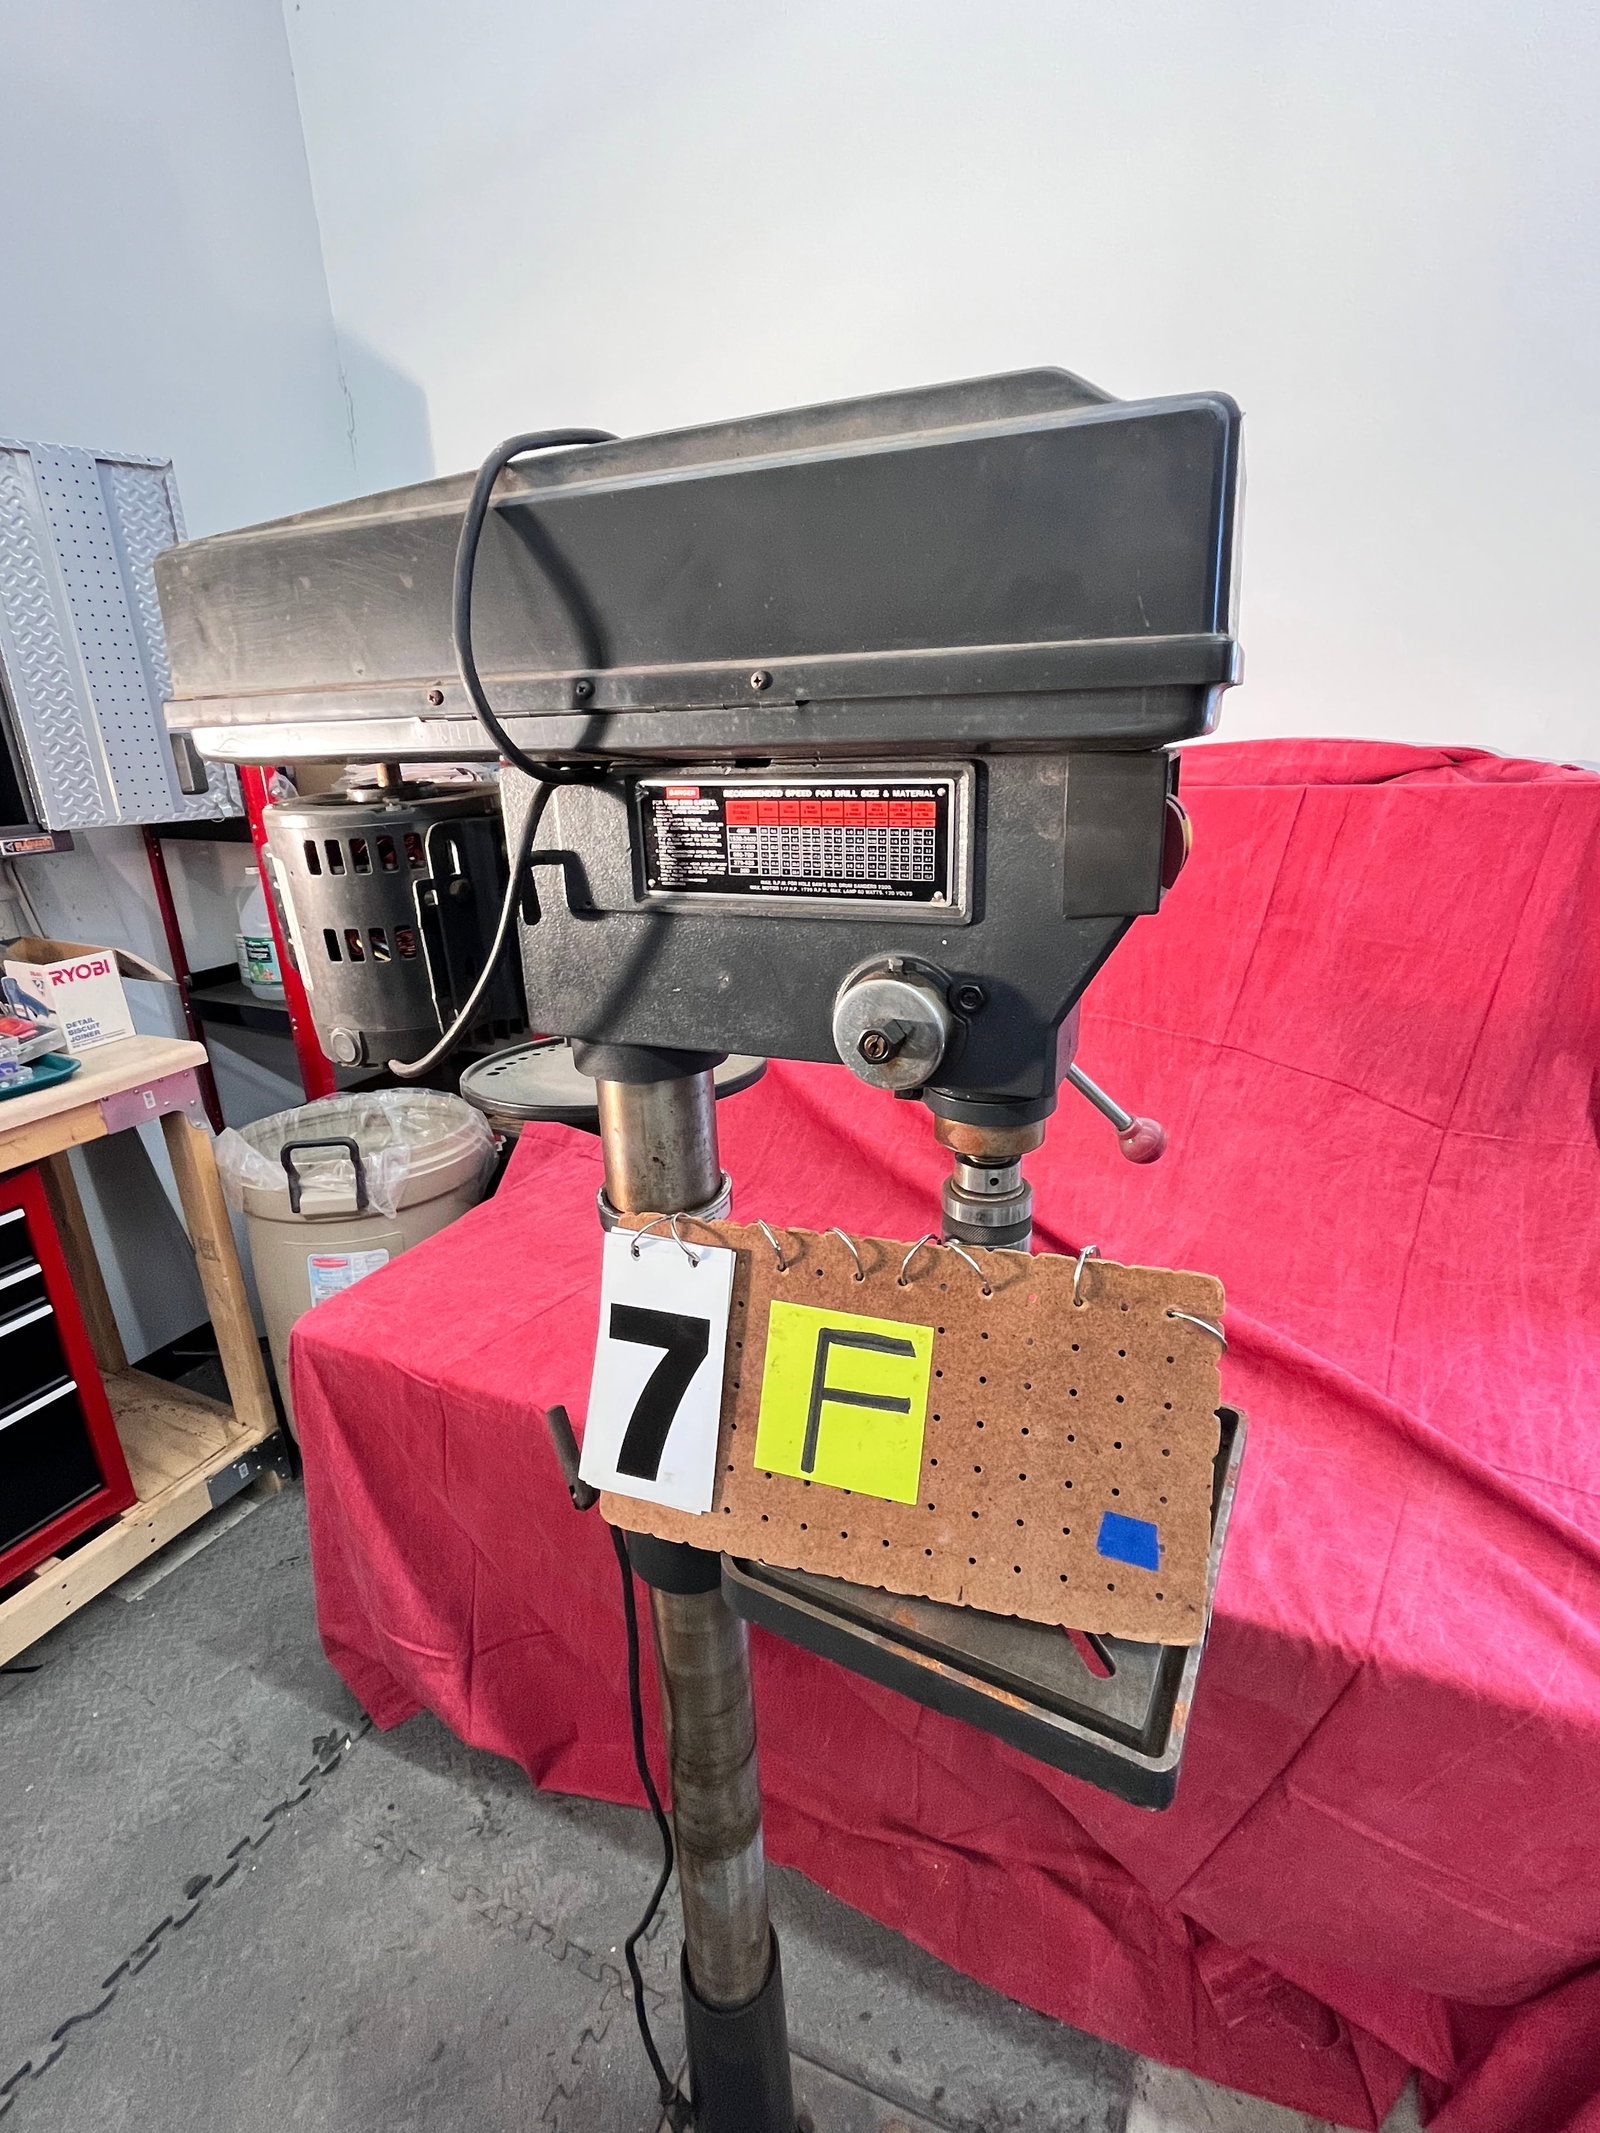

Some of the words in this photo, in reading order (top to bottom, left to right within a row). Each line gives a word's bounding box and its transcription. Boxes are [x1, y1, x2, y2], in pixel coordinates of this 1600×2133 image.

[723, 790, 783, 798] RECOMMENDED
[785, 790, 812, 798] SPEED
[815, 790, 832, 798] FOR
[834, 790, 858, 798] DRILL
[861, 790, 879, 798] SIZE
[883, 790, 889, 798] &
[893, 790, 935, 798] MATERIAL
[49, 959, 110, 986] RYOBI
[66, 1017, 95, 1029] DETAIL
[68, 1023, 100, 1036] BISCUIT
[71, 1030, 101, 1043] JOINER
[609, 1303, 710, 1481] 7
[800, 1327, 916, 1473] F
